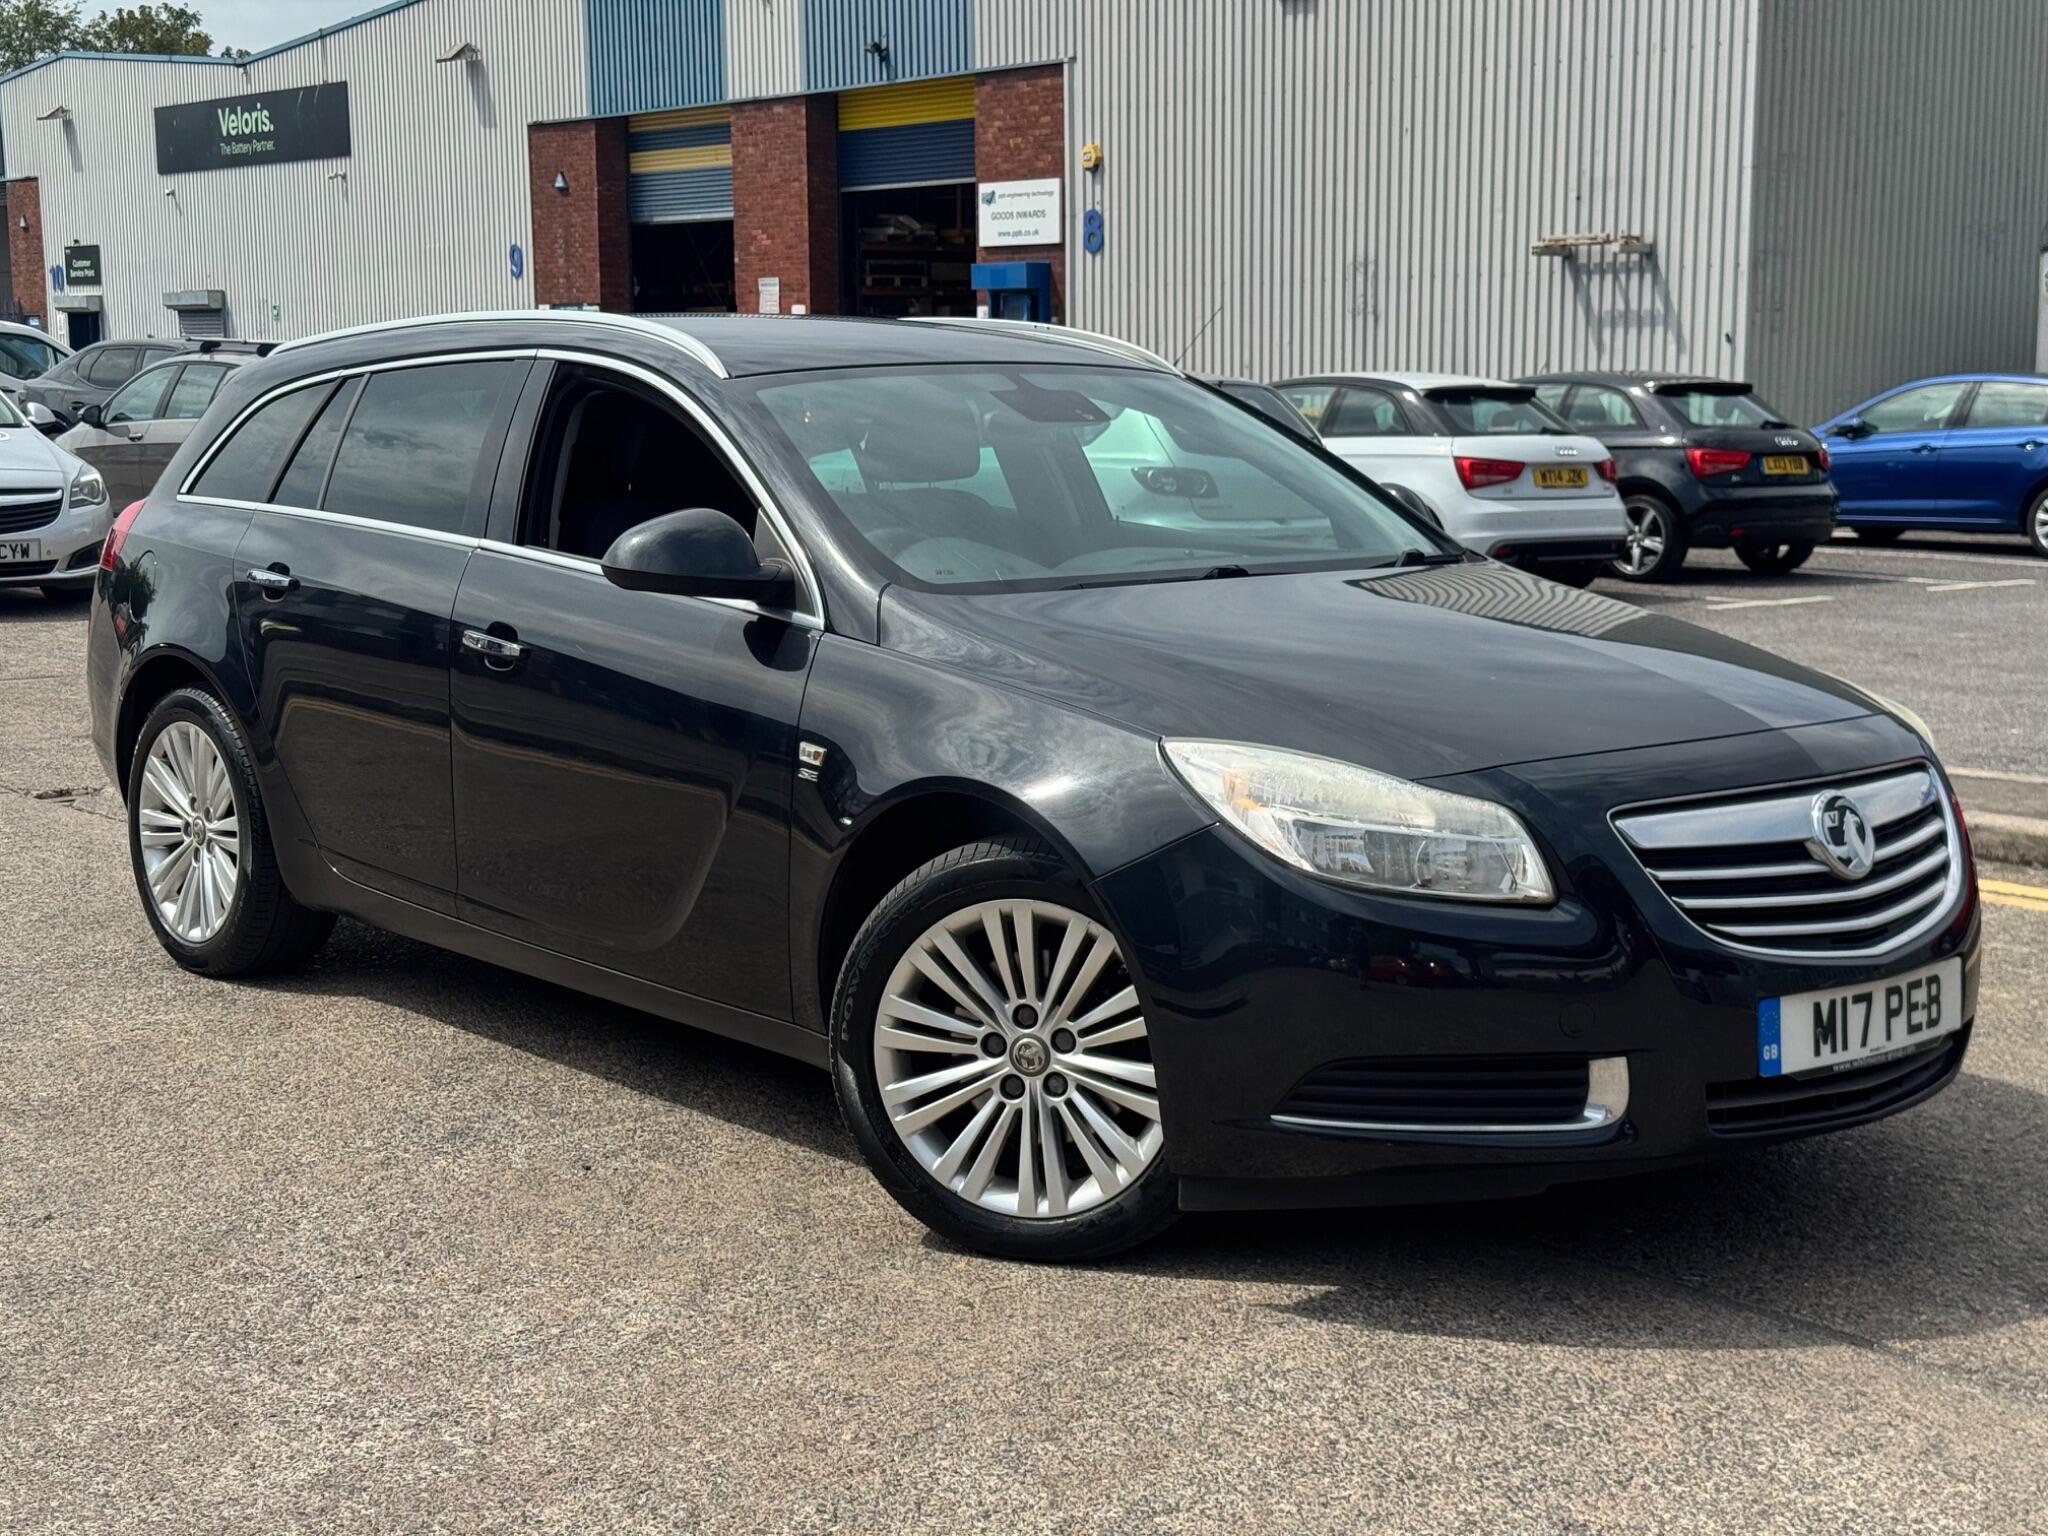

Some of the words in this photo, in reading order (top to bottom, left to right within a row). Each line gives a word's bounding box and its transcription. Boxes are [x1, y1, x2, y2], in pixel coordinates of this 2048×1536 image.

[217, 102, 274, 136] Veloris.
[220, 143, 231, 155] The
[231, 141, 252, 155] Battery
[991, 210, 1014, 221] GOODS
[1016, 208, 1046, 219] INWARDS
[1084, 209, 1104, 254] 8
[510, 244, 523, 280] 9
[49, 264, 64, 292] 10
[0, 543, 30, 559] CYW
[1885, 974, 1941, 1042] PEB
[1763, 1044, 1778, 1060] GB
